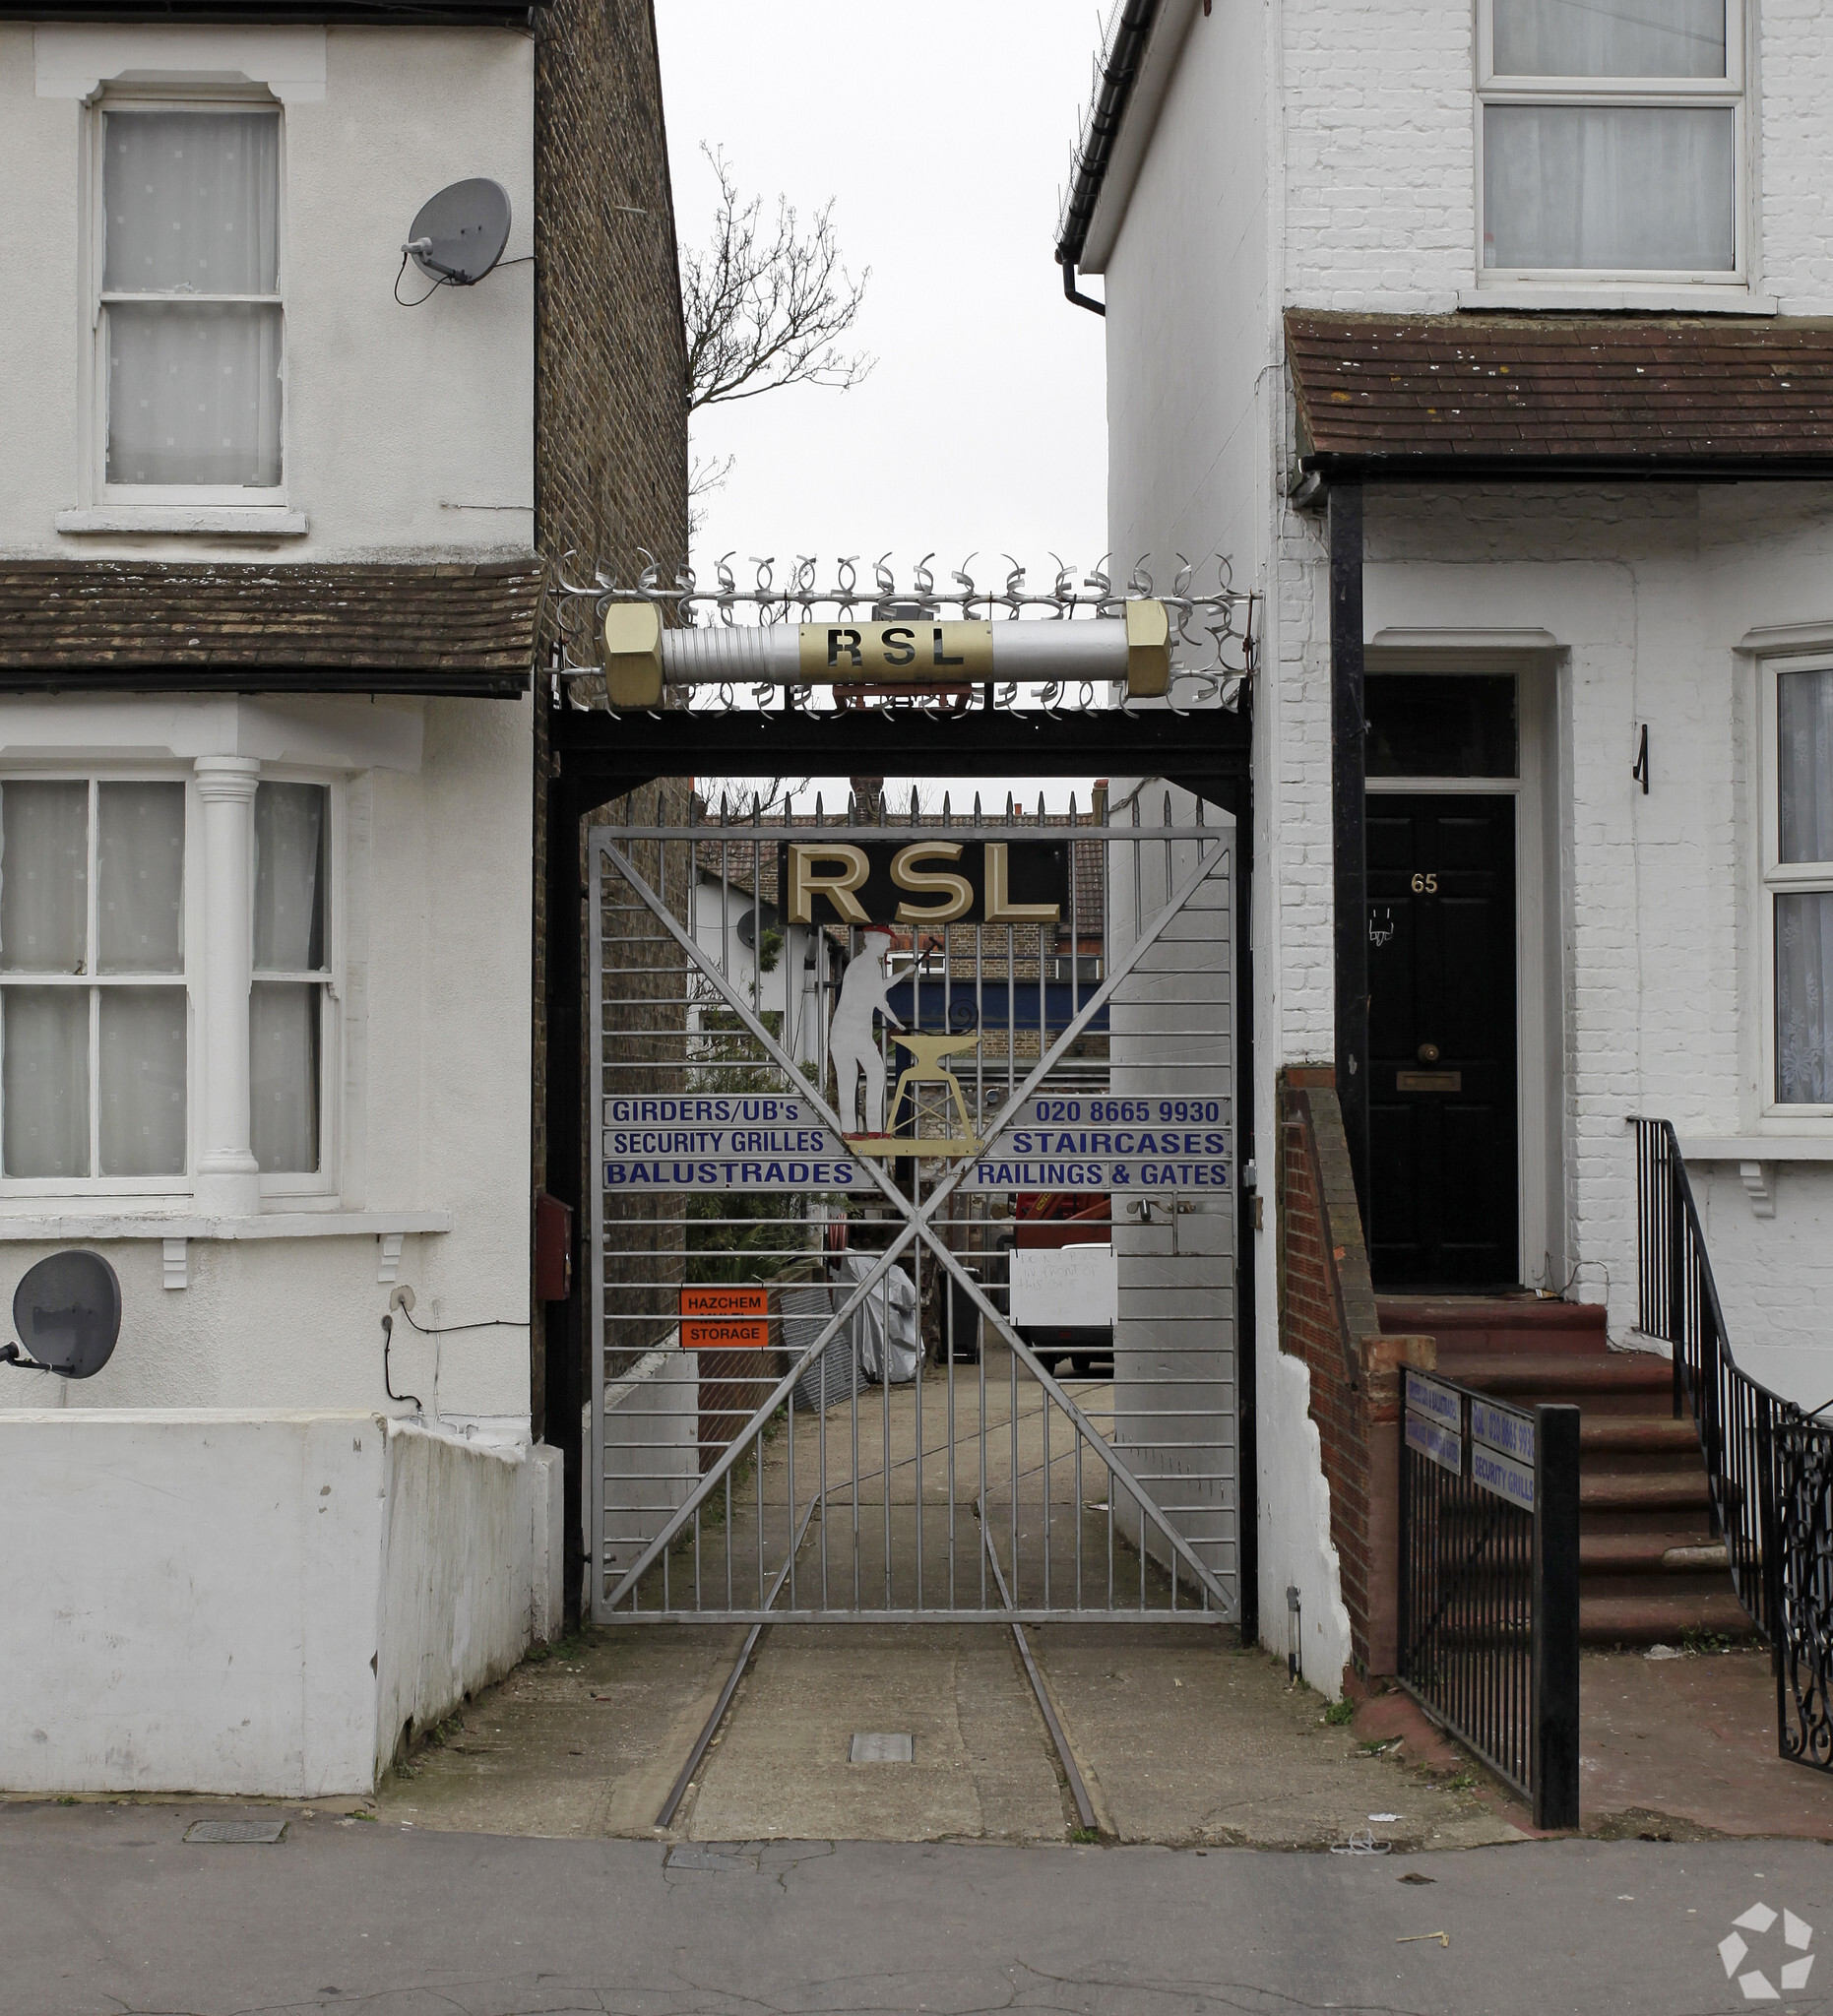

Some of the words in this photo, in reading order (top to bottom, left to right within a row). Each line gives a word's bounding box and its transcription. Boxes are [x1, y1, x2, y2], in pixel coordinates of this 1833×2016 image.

[827, 628, 965, 666] RSL
[788, 842, 1060, 924] RSL
[1411, 873, 1438, 894] 65
[612, 1101, 798, 1123] GIRDERS/UB's
[1036, 1101, 1081, 1122] 020
[1090, 1102, 1150, 1122] 8665
[1159, 1102, 1220, 1122] 9930
[613, 1132, 724, 1154] SECURITY
[731, 1131, 824, 1153] GRILLES
[1012, 1132, 1225, 1155] STAIRCASES
[606, 1163, 853, 1184] BALUSTRADES
[977, 1164, 1104, 1185] RAILINGS
[1111, 1165, 1130, 1185] &
[1141, 1164, 1227, 1186] GATES
[688, 1296, 762, 1310] HAZCHEM
[690, 1327, 760, 1341] STORAGE
[1488, 1411, 1500, 1444] 020
[1501, 1416, 1517, 1451] 8665
[1475, 1454, 1507, 1490] SECURITY
[1507, 1471, 1534, 1502] GRILLS
